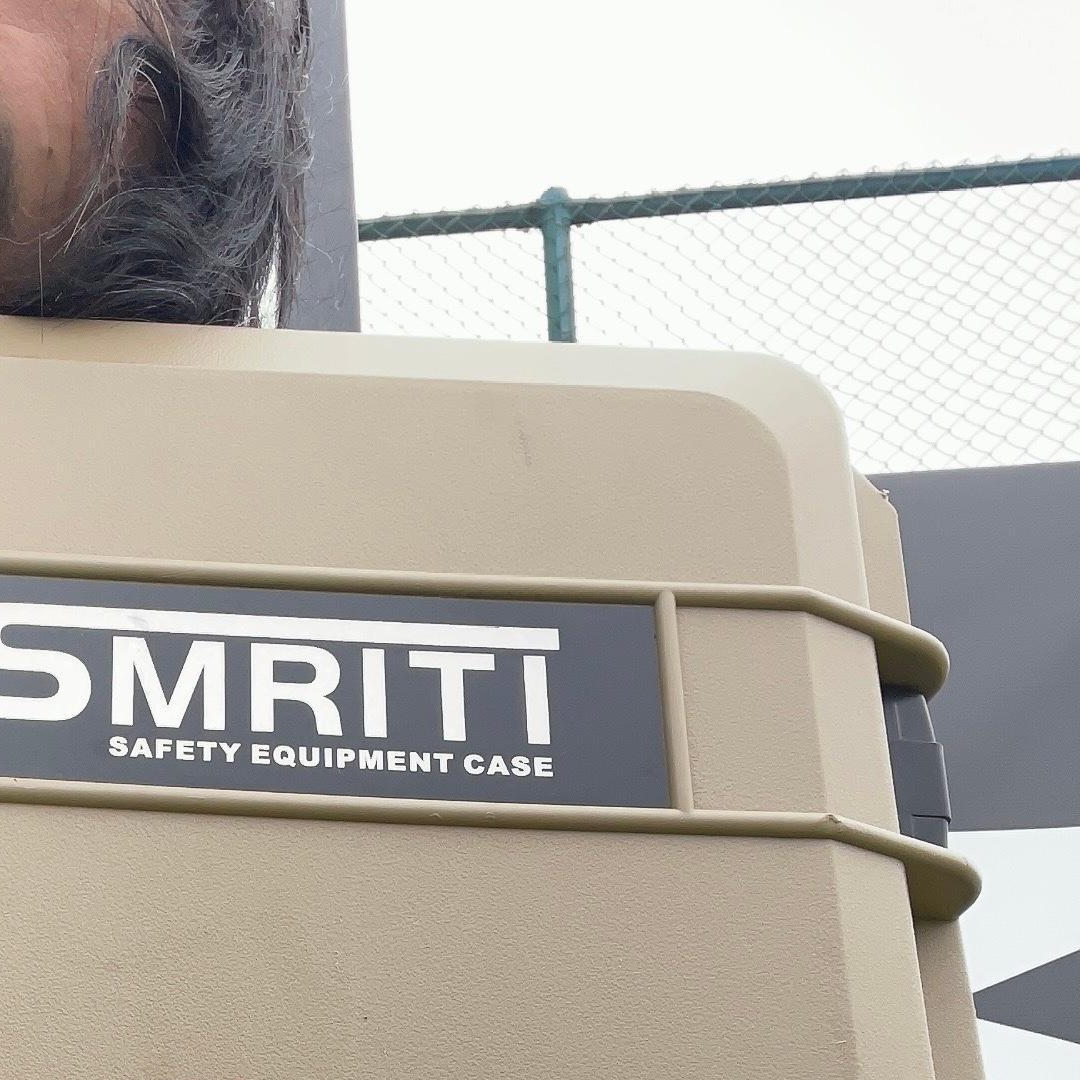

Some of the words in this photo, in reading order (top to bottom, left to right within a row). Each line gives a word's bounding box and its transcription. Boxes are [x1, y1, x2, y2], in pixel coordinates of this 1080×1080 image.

[108, 735, 241, 764] SAFETY
[252, 744, 454, 774] EQUIPMENT
[463, 753, 554, 778] CASE
